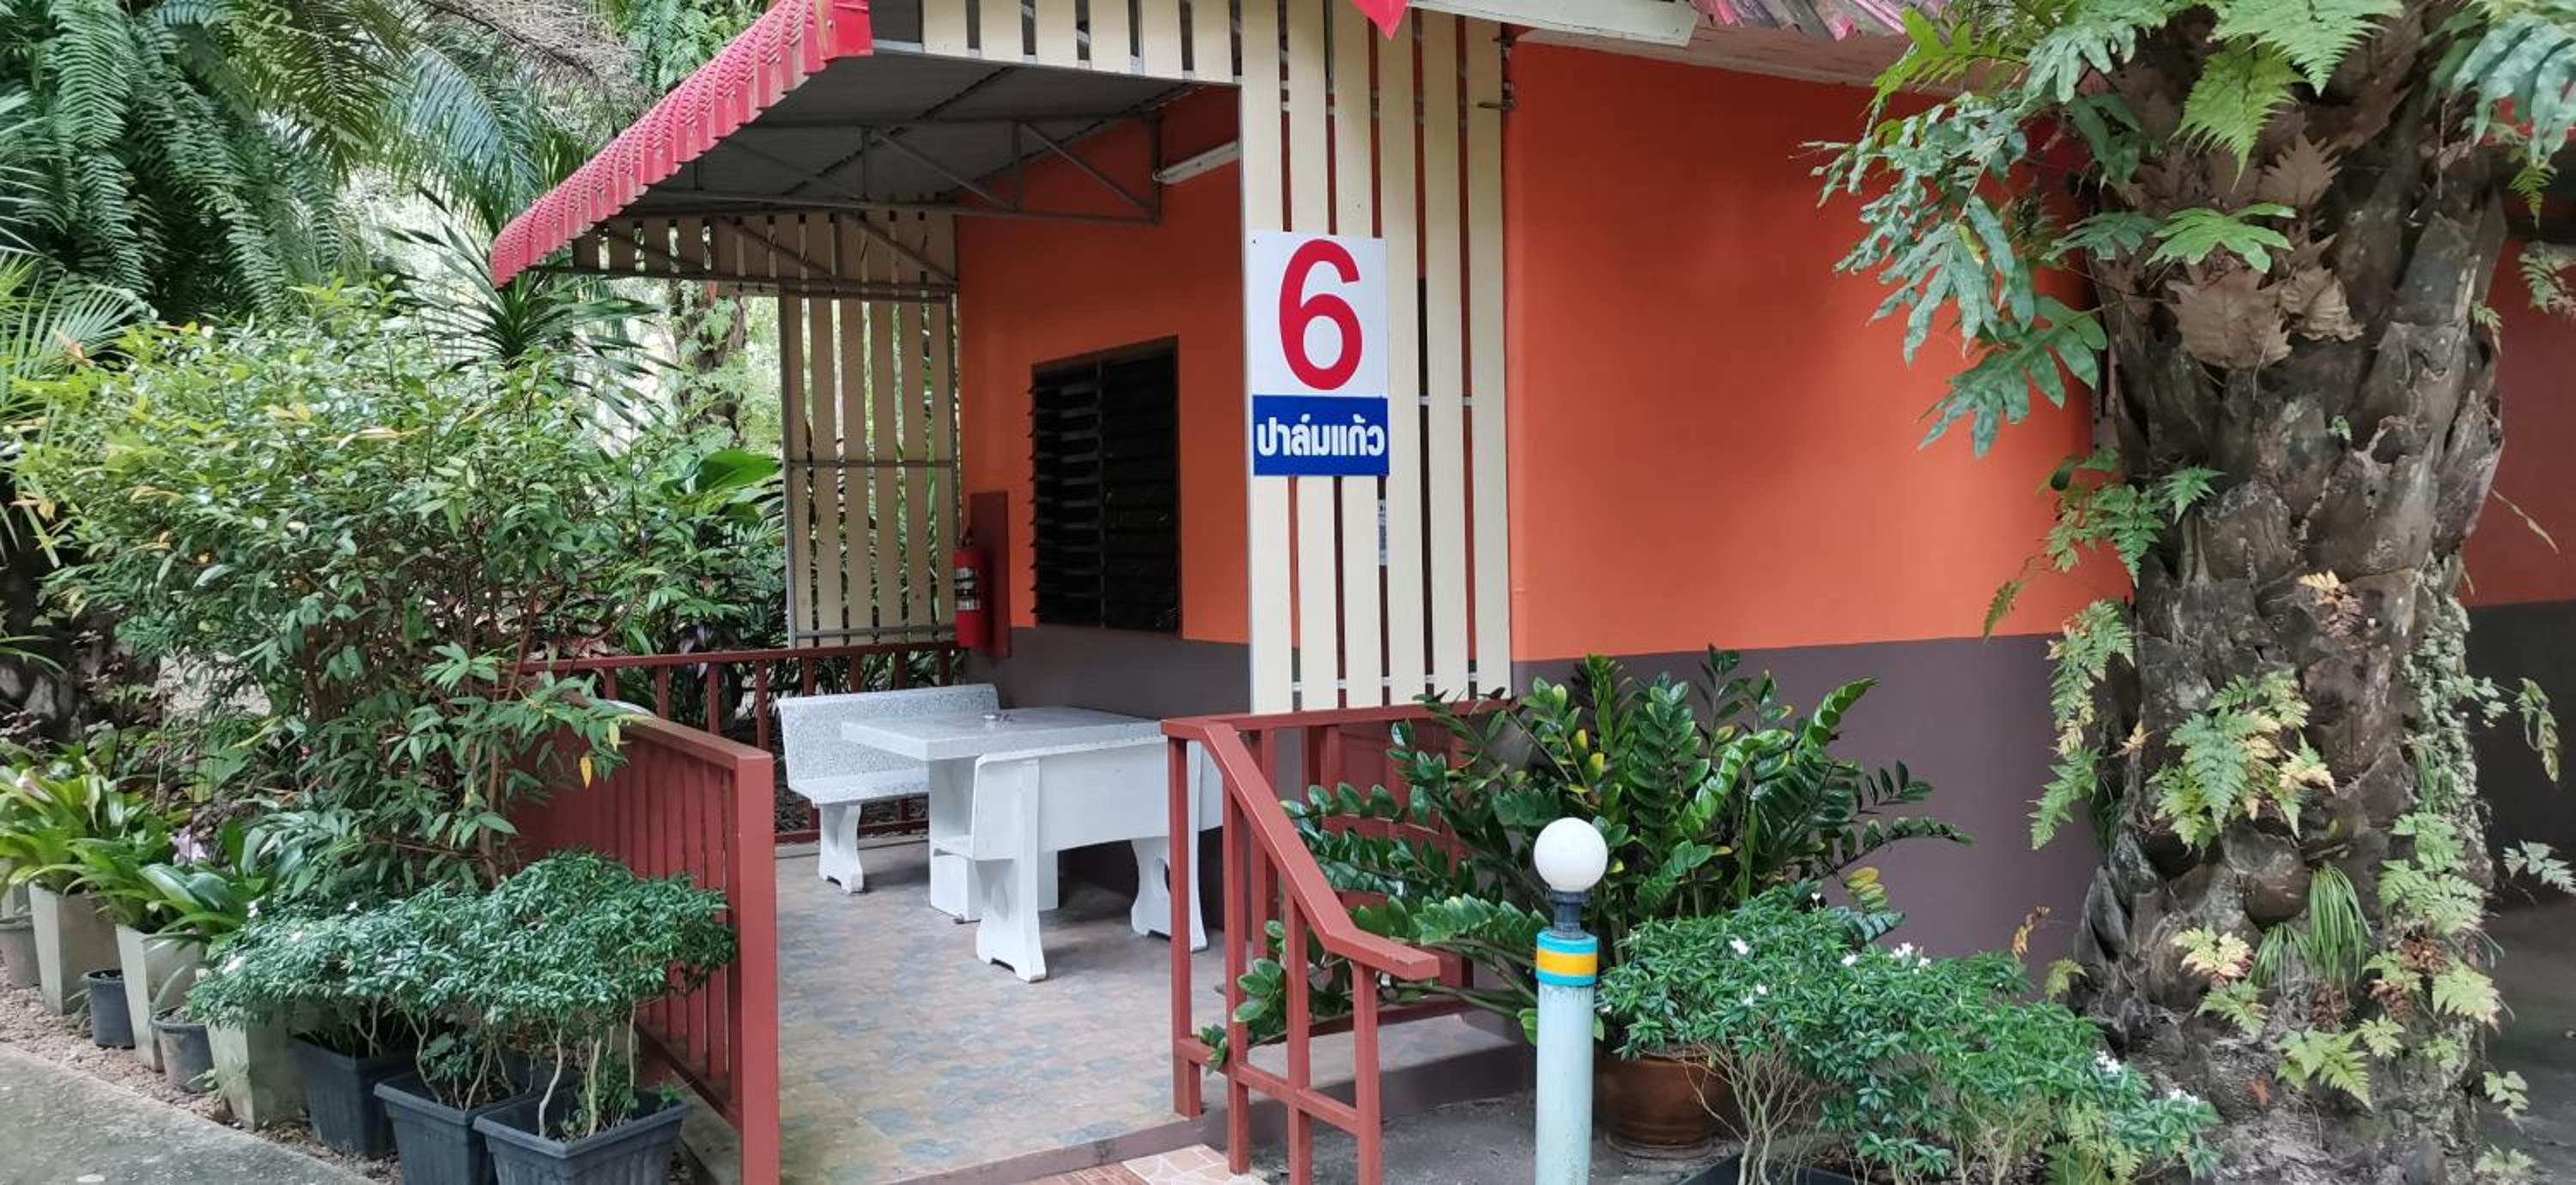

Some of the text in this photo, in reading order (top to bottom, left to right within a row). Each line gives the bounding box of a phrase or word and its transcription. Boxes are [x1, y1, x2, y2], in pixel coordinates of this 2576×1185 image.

[1279, 239, 1363, 391] 6
[1256, 413, 1385, 456] ปาล์มแก้ว
